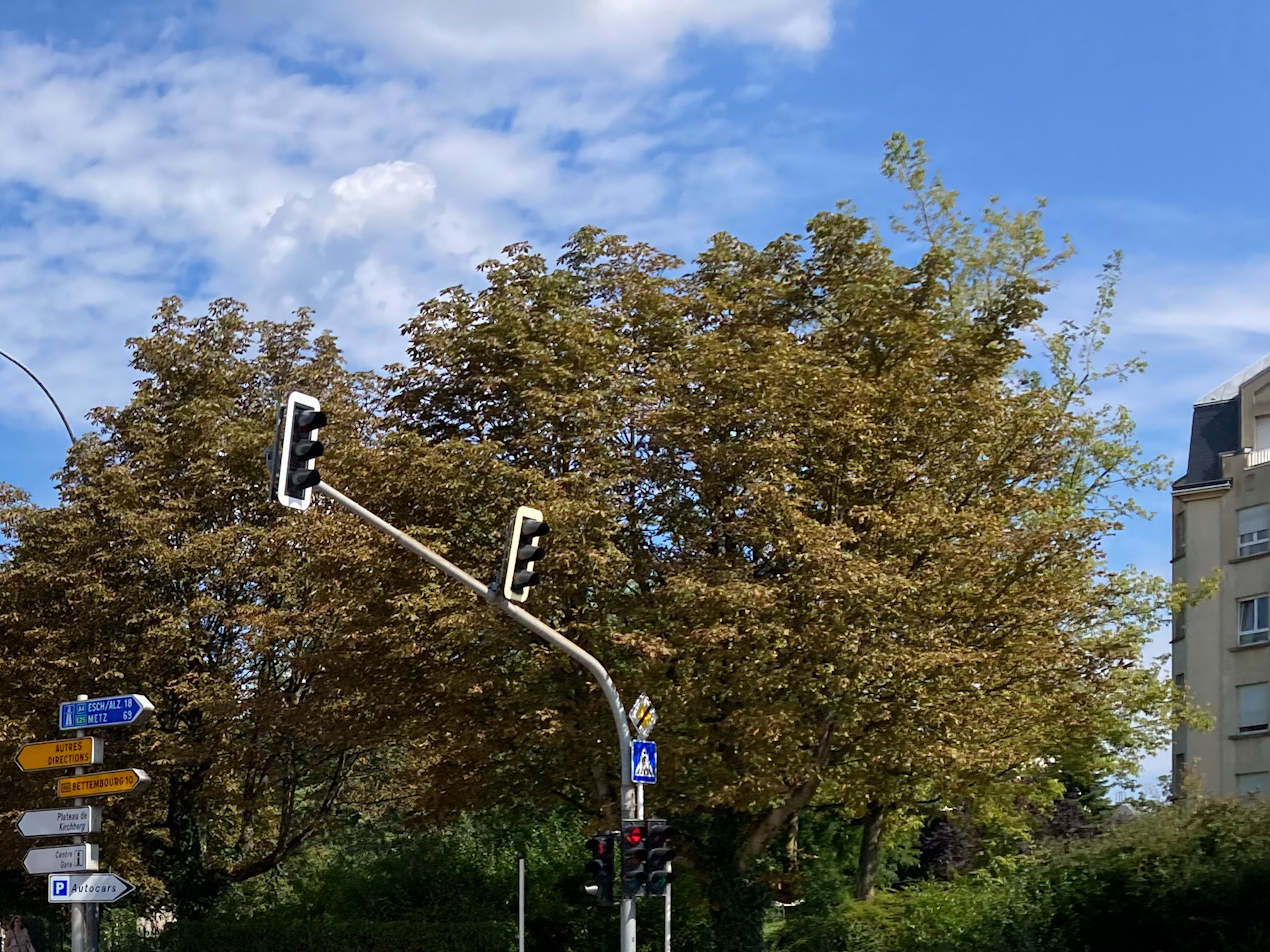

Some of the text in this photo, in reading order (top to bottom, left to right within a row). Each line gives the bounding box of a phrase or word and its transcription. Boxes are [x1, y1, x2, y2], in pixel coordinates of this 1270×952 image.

[124, 698, 133, 708] 18
[87, 710, 133, 724] METZ 69
[55, 742, 82, 753] AUTRES
[48, 753, 89, 765] DIRECTIONS
[72, 776, 124, 791] BETTEMBOURG
[126, 775, 134, 785] 10
[56, 811, 88, 821] Plateau de
[59, 822, 86, 832] Kirchberg
[55, 851, 73, 859] Centre
[55, 882, 117, 895] P Autocars
